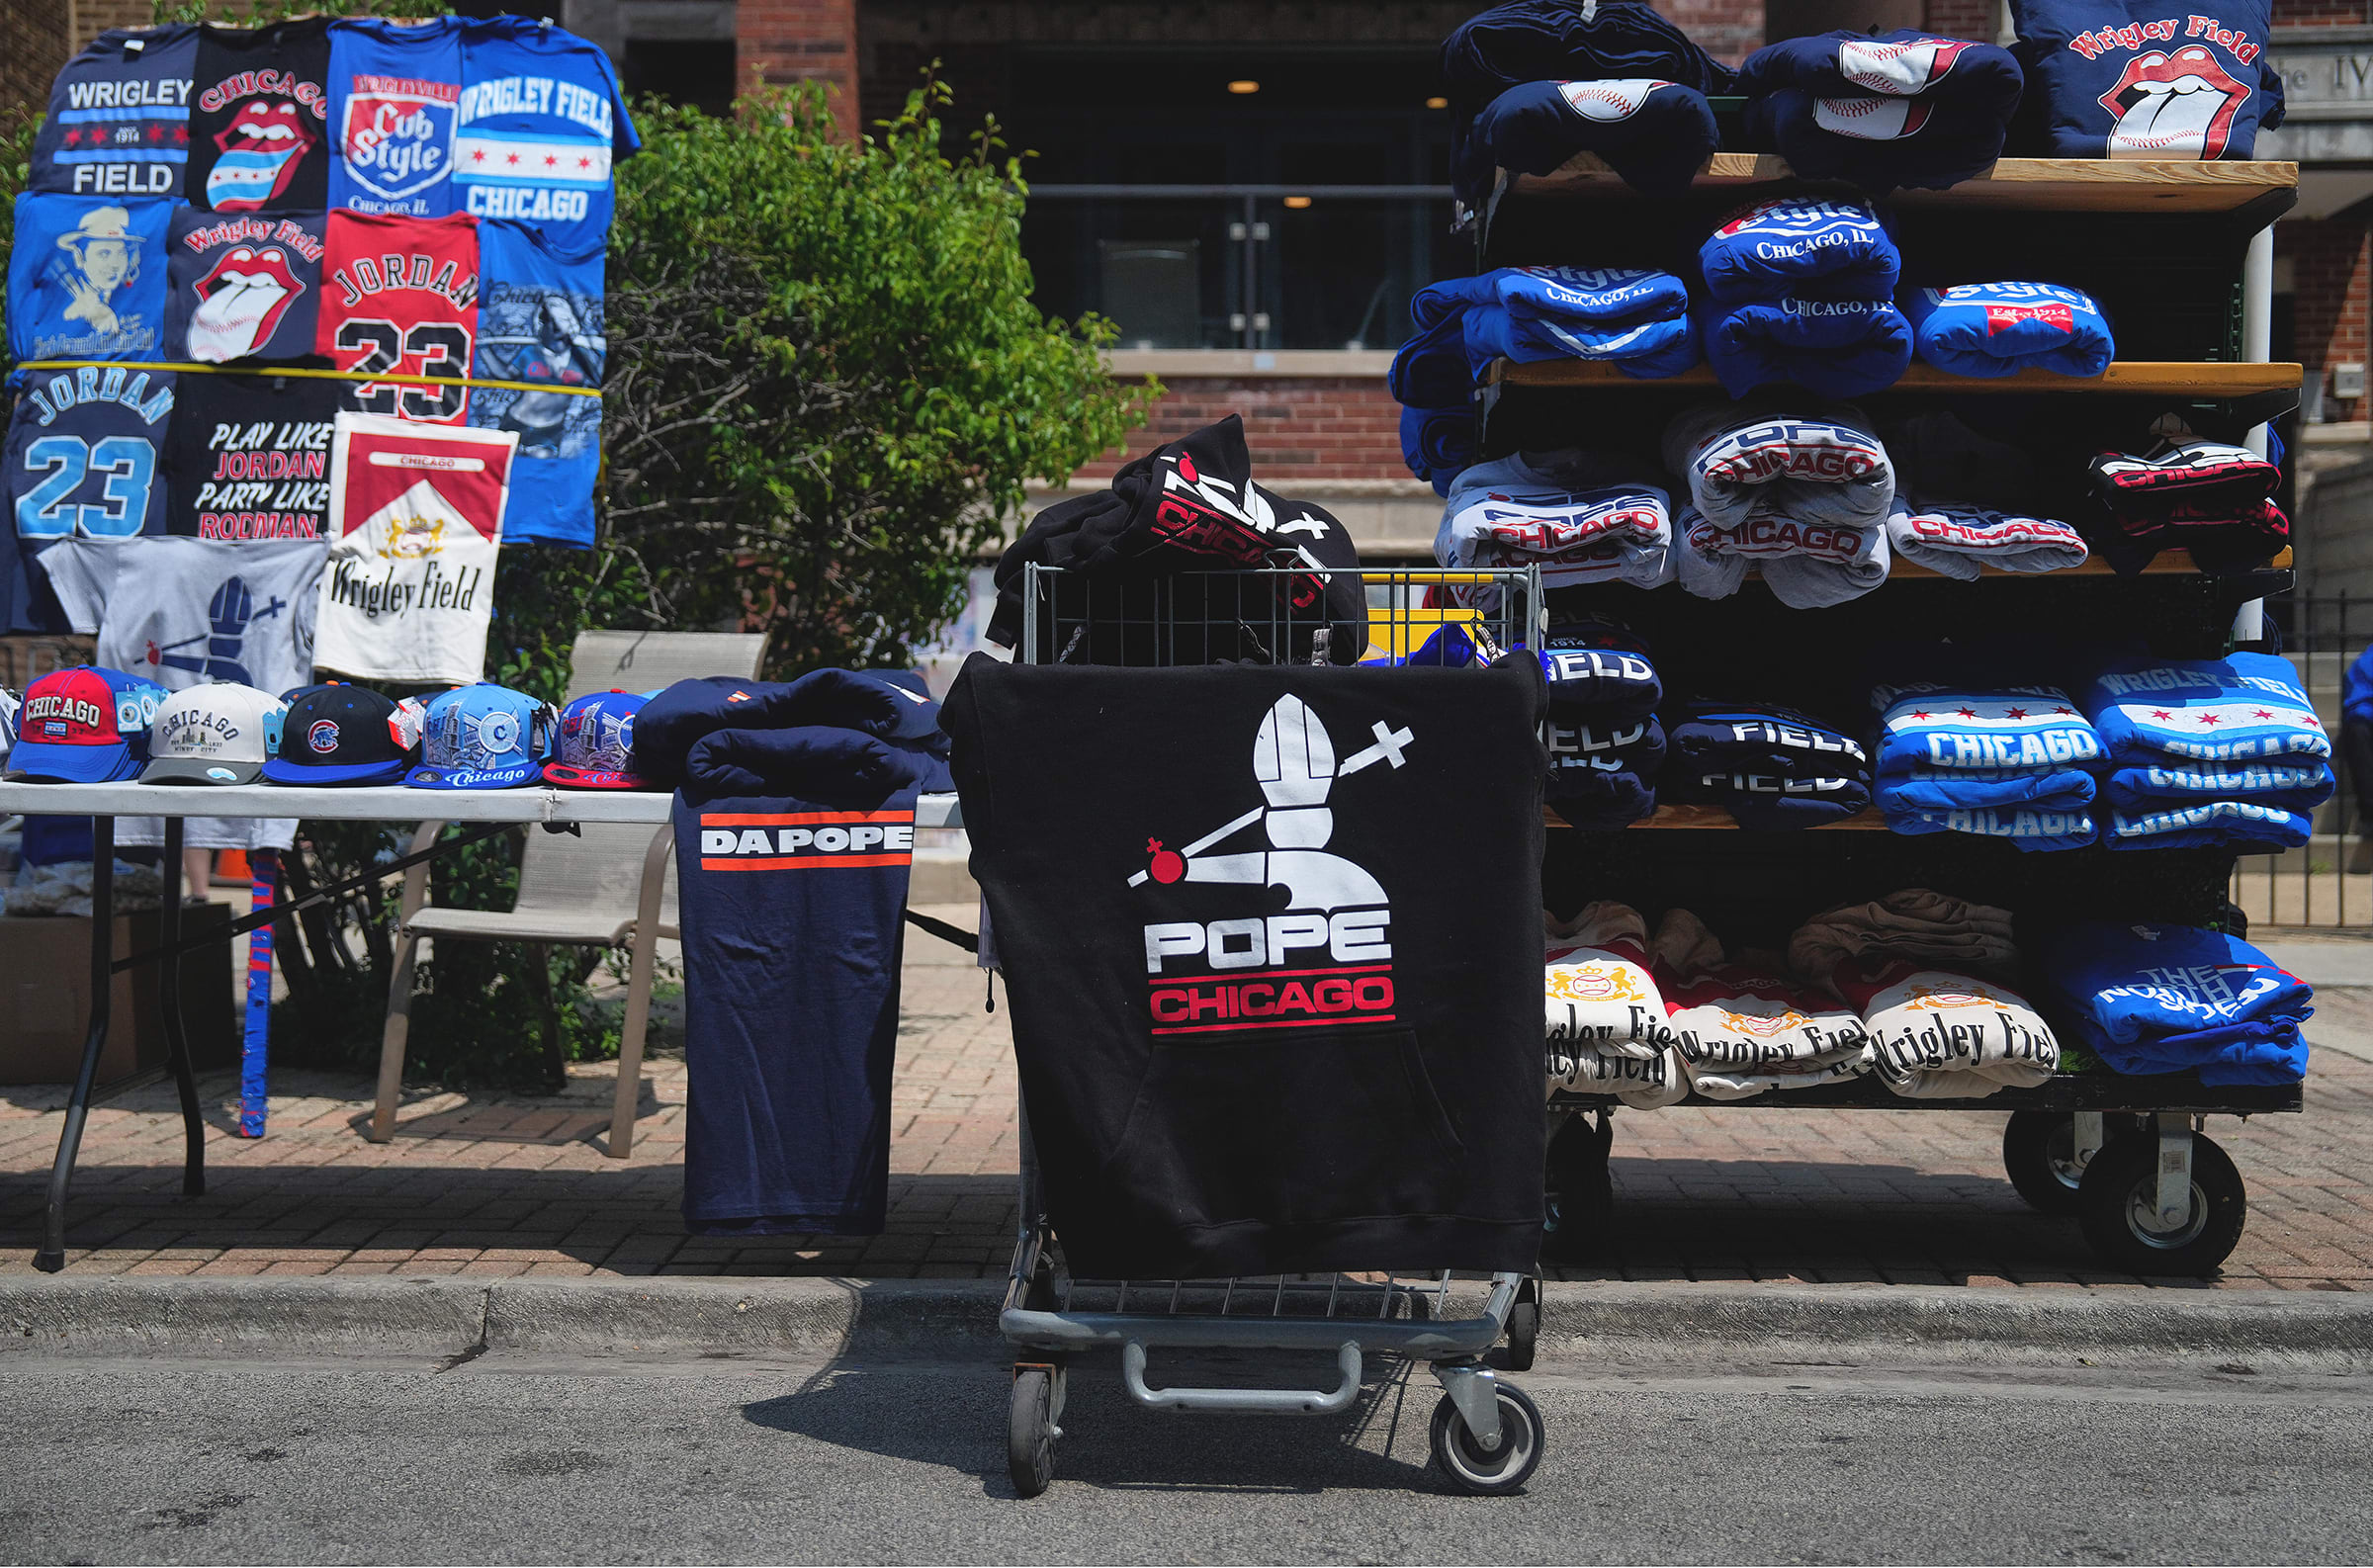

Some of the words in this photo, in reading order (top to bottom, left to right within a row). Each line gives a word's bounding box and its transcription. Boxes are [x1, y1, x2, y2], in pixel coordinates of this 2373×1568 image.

[2069, 19, 2179, 60] Wrigley
[2184, 14, 2261, 66] Field
[2278, 56, 2310, 90] he
[68, 79, 194, 109] WRIGLEY
[459, 76, 553, 127] WRIGLEY
[374, 103, 435, 140] Cub
[352, 127, 442, 183] Style
[73, 164, 174, 194] FIELD
[467, 185, 590, 220] CHICAGO
[184, 217, 276, 254] Wrigley
[273, 218, 325, 264] Field
[1850, 228, 1875, 245] IL
[333, 253, 480, 312] JORDAN
[1946, 282, 2078, 303] Style
[1992, 307, 2027, 317] Est.
[334, 317, 472, 421] 23
[29, 366, 175, 426] JORDAN
[209, 422, 273, 450] PLAY
[277, 422, 334, 450] LIKE
[213, 451, 325, 479] JORDAN
[399, 455, 456, 468] CHICAGO
[15, 435, 156, 538] 23
[194, 482, 270, 509] PARTY
[272, 482, 331, 510] LIKE
[1491, 511, 1659, 549] CHICAGO
[1690, 520, 1862, 557] CHICAGO
[331, 559, 415, 619] Wrigley
[416, 561, 482, 612] Field
[1547, 653, 1653, 680] IELD
[2096, 667, 2223, 696] WRIGLEY
[26, 695, 102, 729] CHICAGO
[162, 709, 239, 740] CHICAGO
[1547, 721, 1644, 751] ELD
[1926, 730, 2100, 768] CHICAGO
[445, 768, 525, 787] Chicago
[701, 828, 774, 854] DA
[778, 826, 914, 853] POPE
[1923, 809, 2092, 838] HICAGO
[1144, 910, 1392, 973] POPE
[2136, 965, 2221, 986] THE
[1150, 977, 1394, 1022] CHICAGO
[1868, 1012, 1984, 1085] Wrigley
